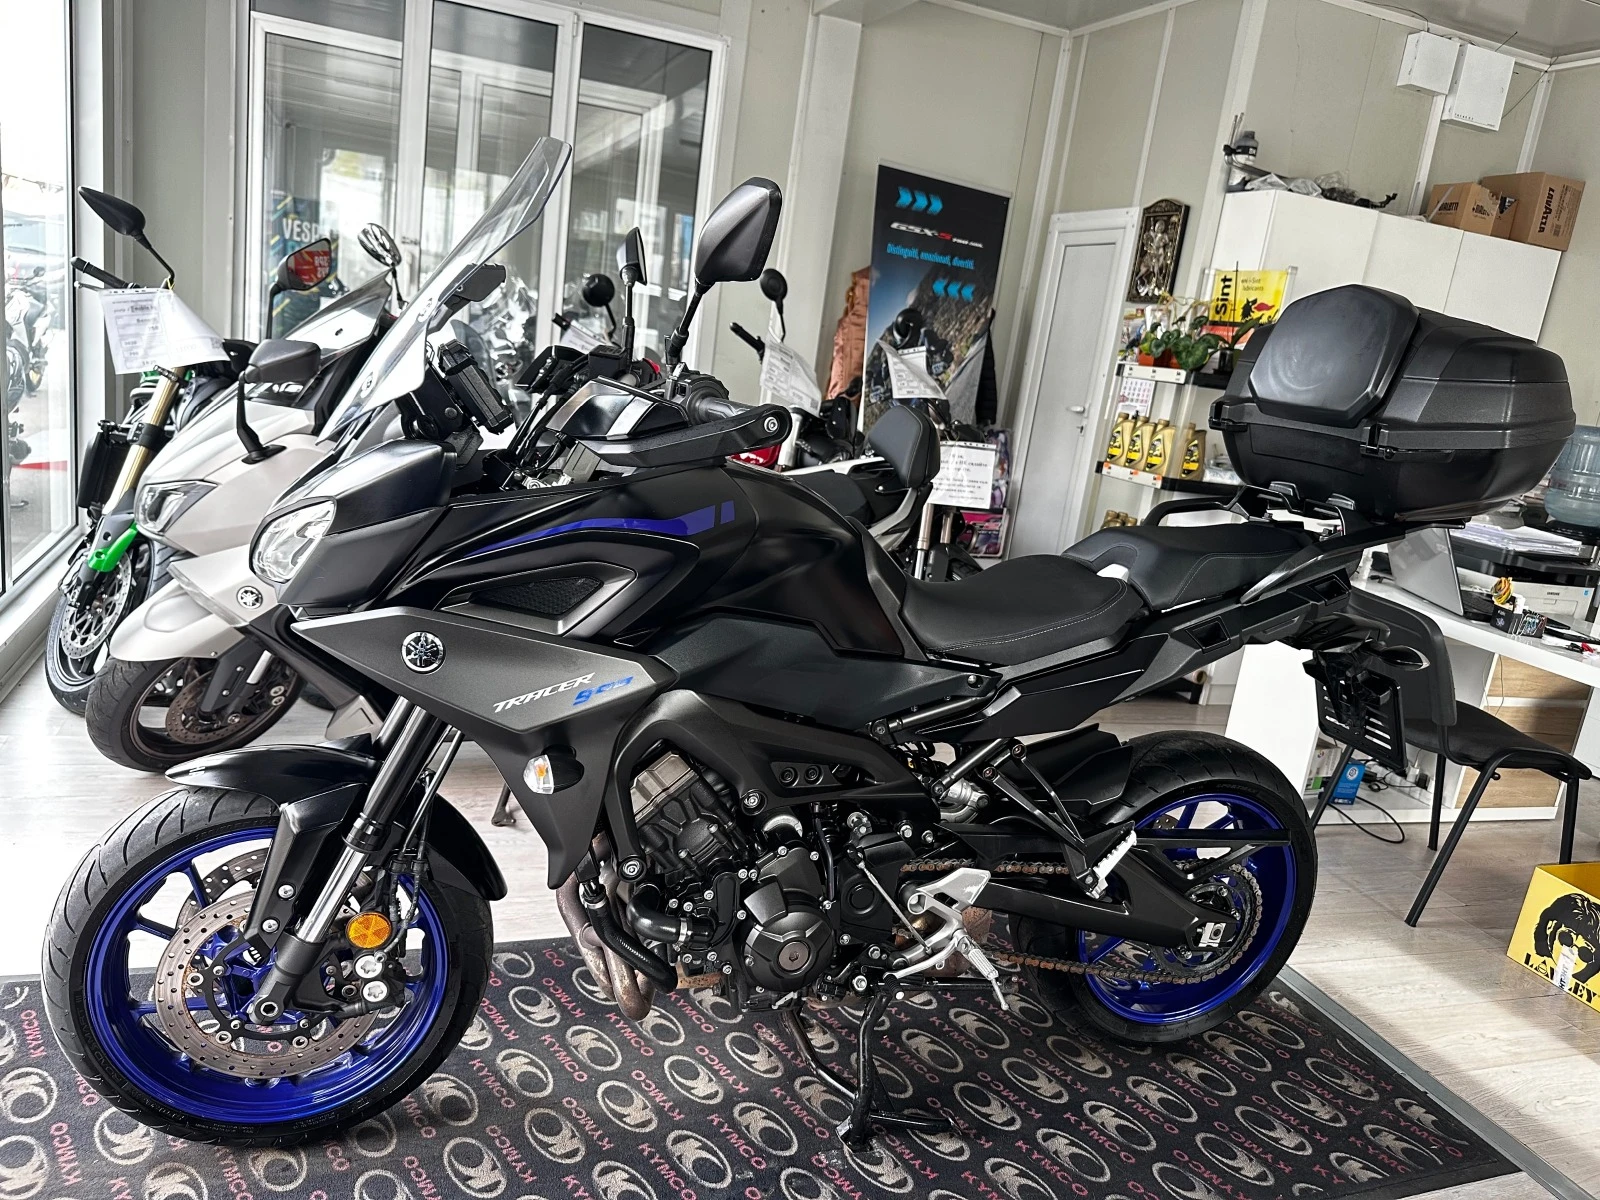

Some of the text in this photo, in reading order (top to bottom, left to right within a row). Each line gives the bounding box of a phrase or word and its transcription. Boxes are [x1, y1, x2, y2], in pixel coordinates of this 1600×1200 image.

[493, 672, 595, 713] TRACER
[542, 978, 586, 1019] KYMCO
[667, 991, 715, 1033] KYMCO
[975, 996, 1033, 1036] KYMCO
[20, 1009, 47, 1058] KYMCO
[605, 1012, 655, 1056] KYMCO
[929, 1016, 989, 1059] KYMCO
[1223, 1020, 1290, 1059] KYMCO
[540, 1034, 588, 1082] KYMCO
[695, 1045, 749, 1093] KYMCO
[881, 1038, 939, 1083] KYMCO
[1023, 1048, 1088, 1093] KYMCO
[1187, 1039, 1256, 1082] KYMCO
[1320, 1048, 1393, 1091] KYMCO
[468, 1058, 516, 1108] KYMCO
[631, 1070, 685, 1121] KYMCO
[977, 1071, 1042, 1119] KYMCO
[1149, 1062, 1219, 1107] KYMCO
[1286, 1070, 1363, 1116] KYMCO
[562, 1097, 614, 1150] KYMCO
[770, 1087, 829, 1138] KYMCO
[1108, 1086, 1179, 1134] KYMCO
[1252, 1095, 1328, 1143] KYMCO
[1381, 1109, 1463, 1158] KYMCO
[50, 1122, 82, 1187] KYMCO
[485, 1125, 537, 1183] KYMCO
[707, 1113, 767, 1169] KYMCO
[872, 1124, 939, 1179] KYMCO
[1063, 1112, 1136, 1163] KYMCO
[1213, 1121, 1293, 1174] KYMCO
[1348, 1136, 1412, 1174] KYMC
[639, 1143, 697, 1200] KYMCO
[811, 1154, 863, 1200] YMCO
[1015, 1140, 1088, 1196] KYMCO
